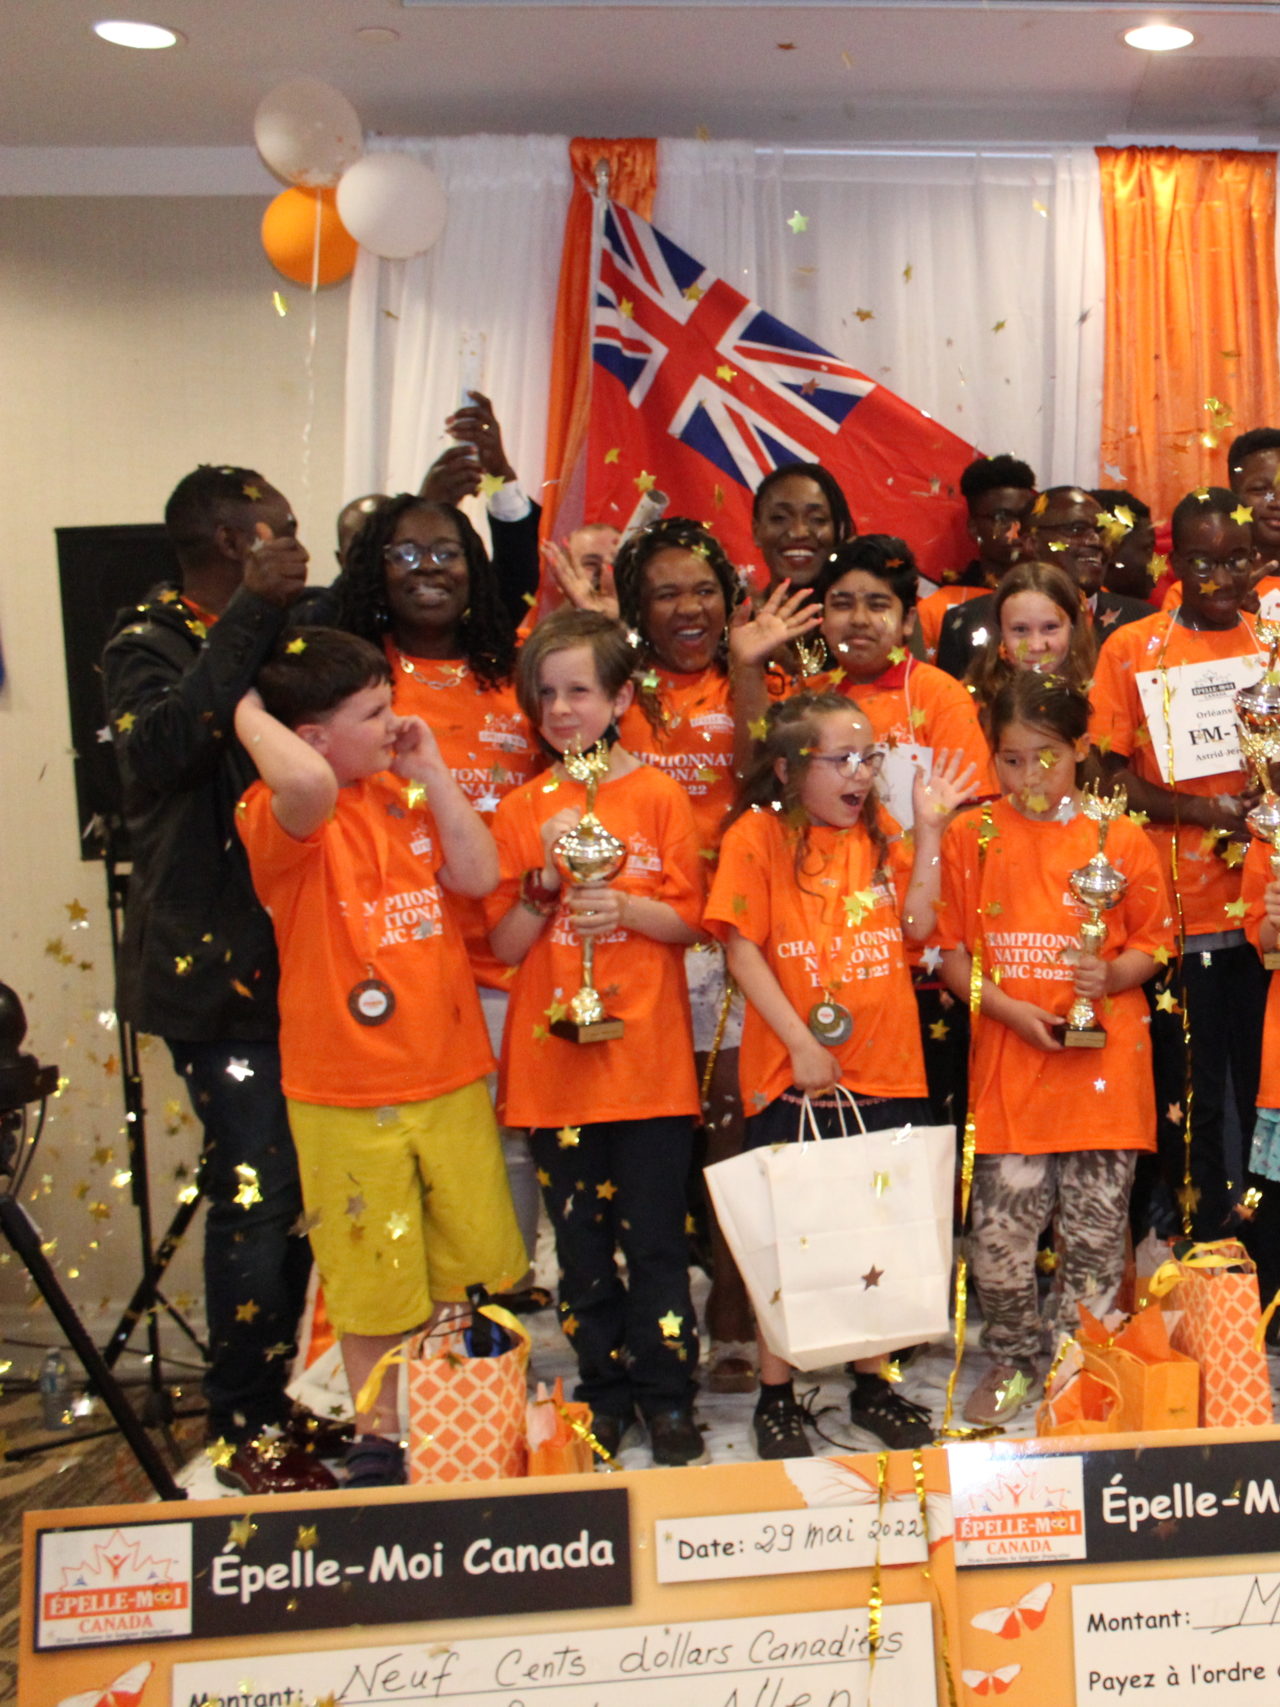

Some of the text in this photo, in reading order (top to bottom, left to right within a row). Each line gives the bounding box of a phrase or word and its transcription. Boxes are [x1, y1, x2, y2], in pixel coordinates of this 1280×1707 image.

[678, 1538, 745, 1561] Date:
[755, 1523, 796, 1553] 29
[986, 1538, 1052, 1555] CANADA
[211, 1529, 616, 1604] Épelle-Moi Canada
[78, 1614, 155, 1634] CANADA
[1086, 1609, 1192, 1633] Montant:
[337, 1651, 460, 1701] Neuf
[494, 1645, 587, 1687] Cents
[619, 1630, 735, 1674] dollars
[1088, 1670, 1156, 1697] Payez
[1166, 1665, 1180, 1686] à
[1190, 1661, 1267, 1685] l'ordre
